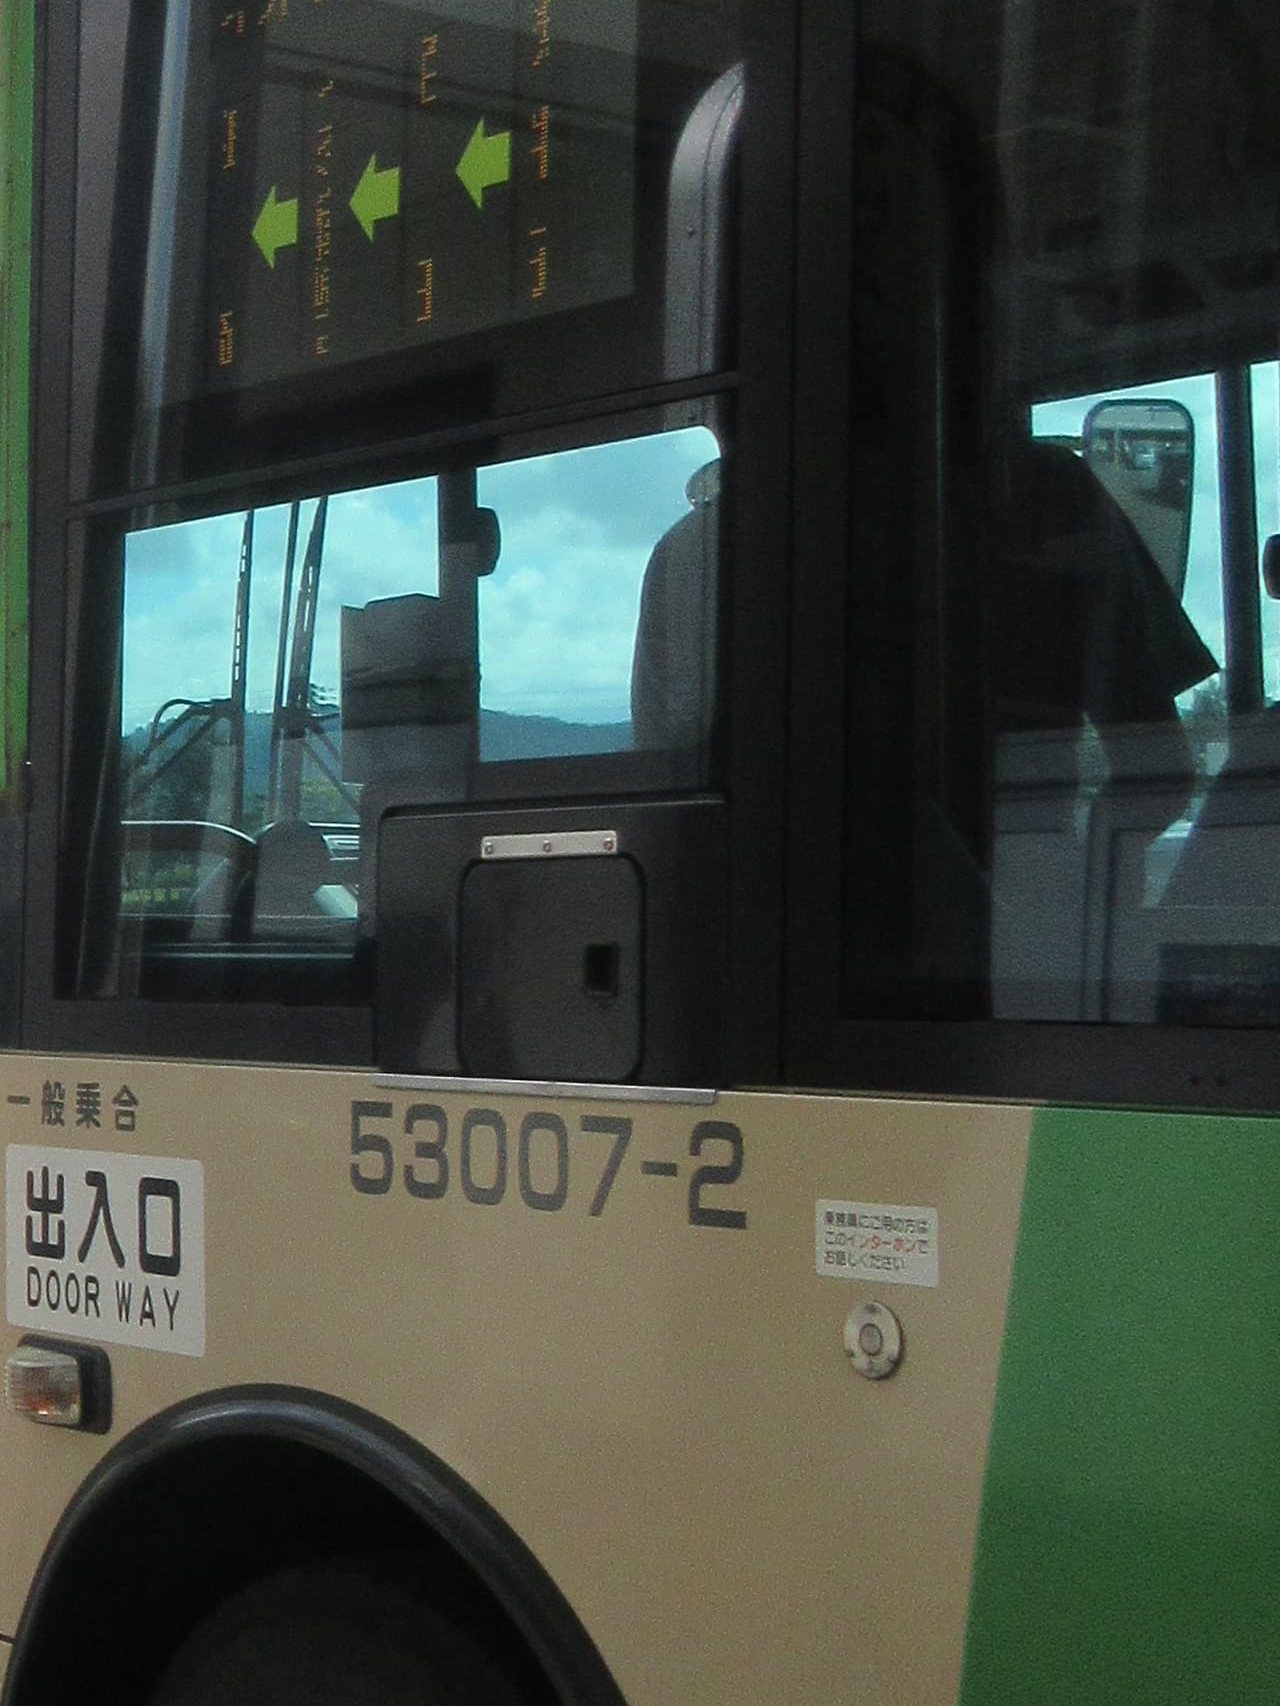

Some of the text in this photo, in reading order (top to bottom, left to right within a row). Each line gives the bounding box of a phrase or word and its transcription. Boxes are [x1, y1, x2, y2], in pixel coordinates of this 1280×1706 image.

[6, 1079, 139, 1132] 一般乗合
[349, 1100, 748, 1230] 53007-2
[25, 1165, 181, 1277] 出入口
[26, 1265, 180, 1331] DOOR WAY
